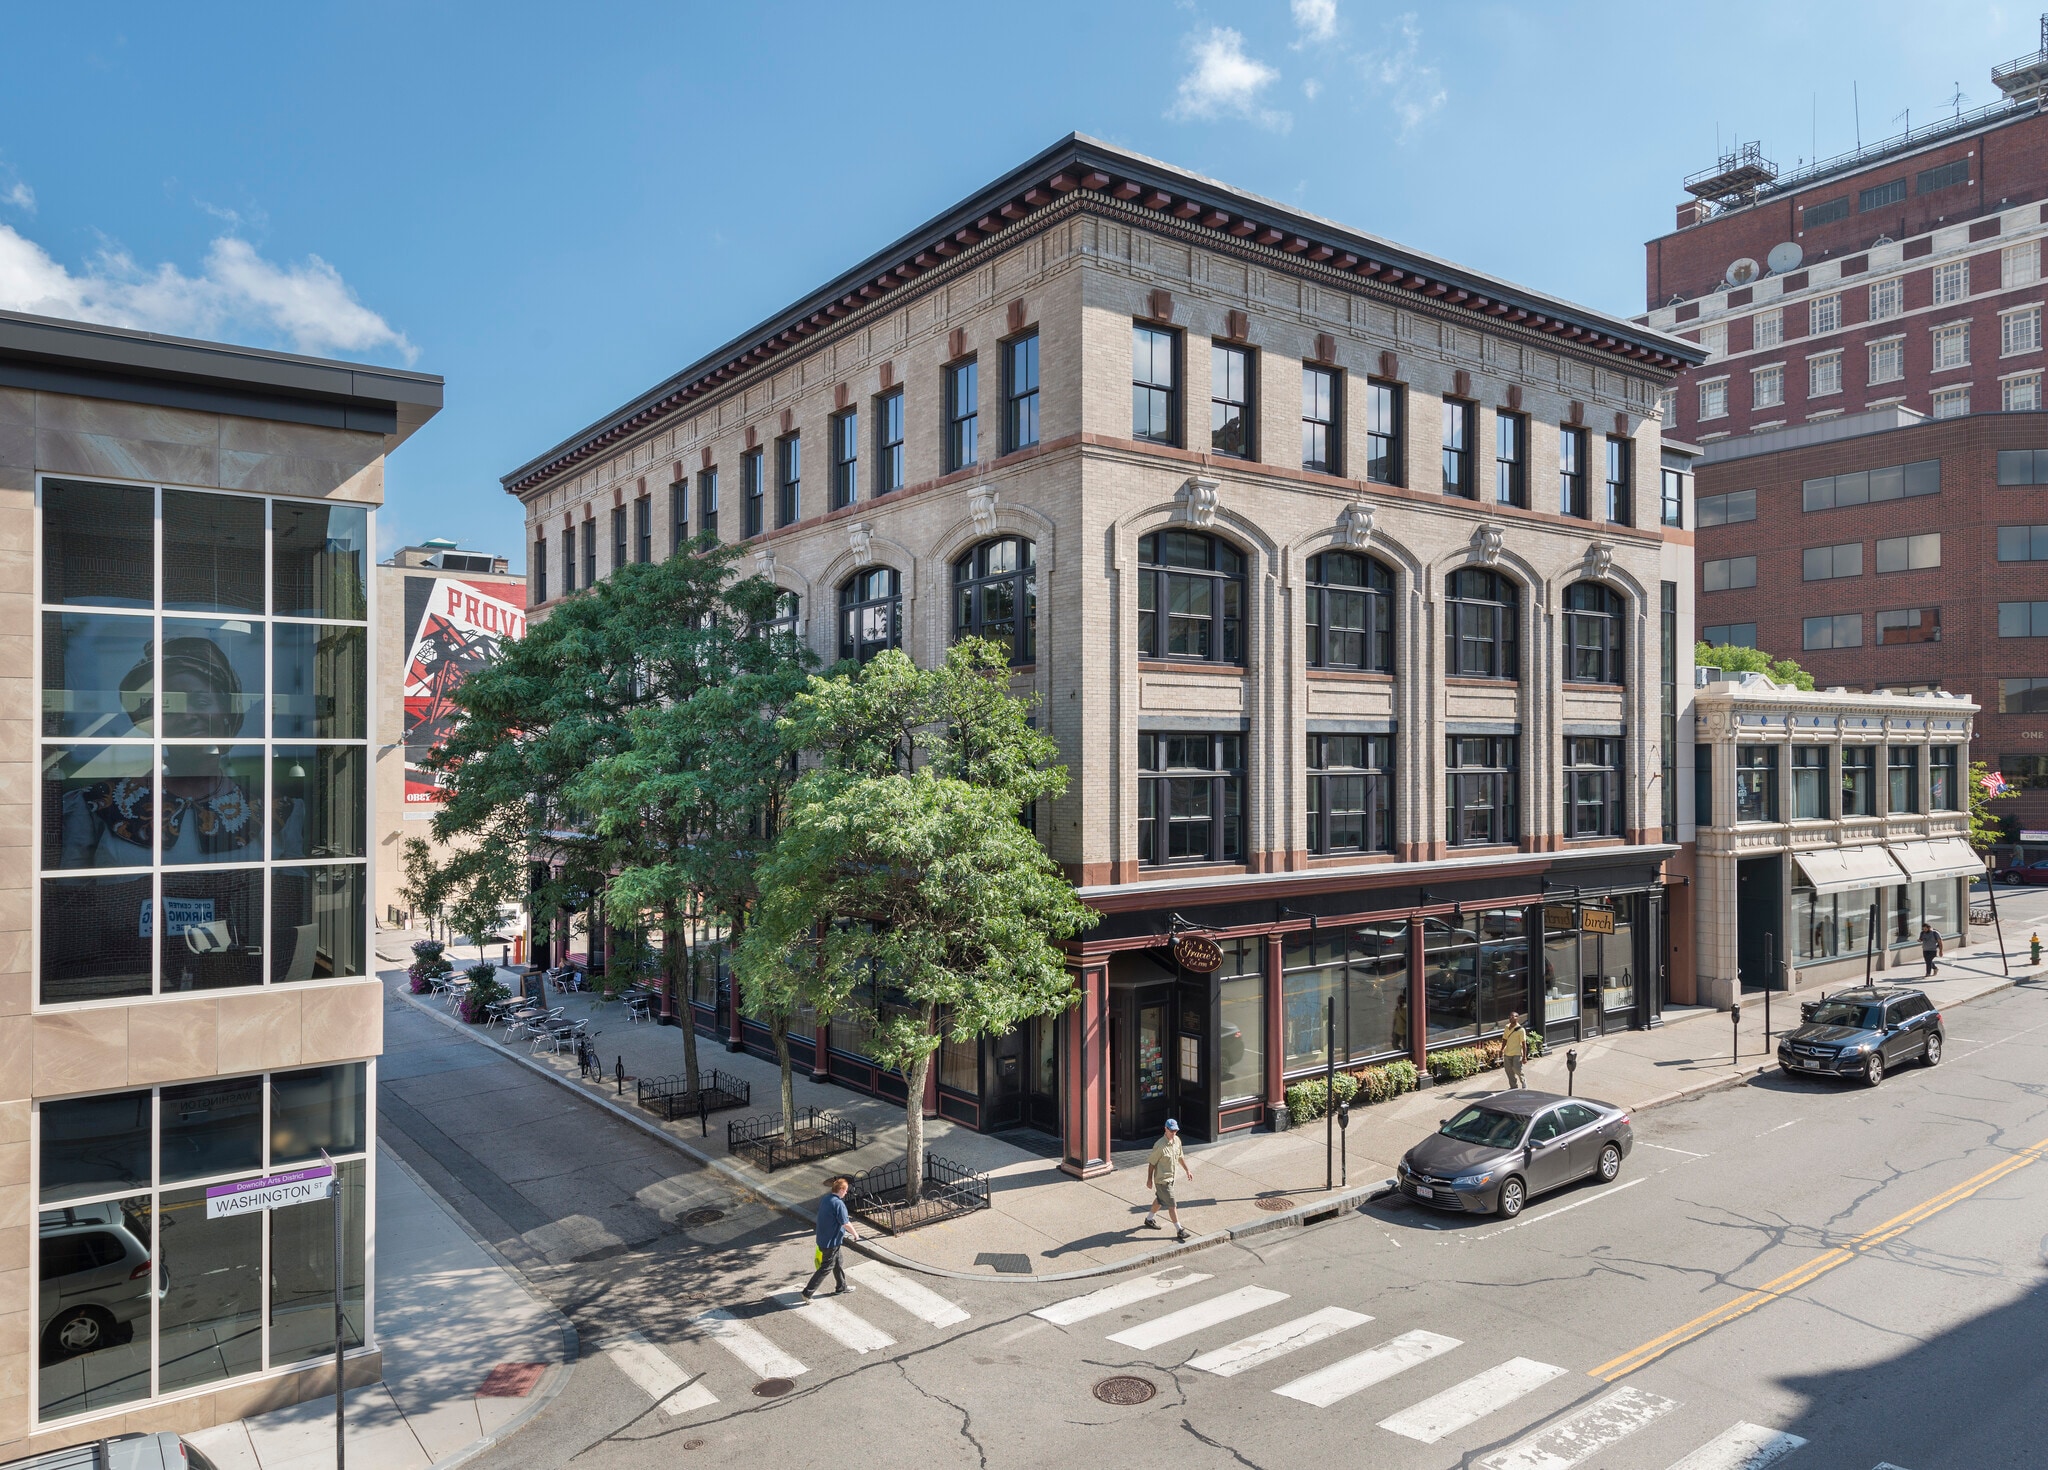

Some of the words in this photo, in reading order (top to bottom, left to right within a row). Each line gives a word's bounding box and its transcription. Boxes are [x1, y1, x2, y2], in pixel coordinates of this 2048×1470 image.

[2021, 731, 2045, 739] ONE
[406, 793, 431, 802] OBEY
[1584, 912, 1611, 930] birch
[1179, 940, 1217, 961] Gracie's
[236, 1180, 267, 1191] Downcity
[267, 1177, 281, 1185] Arts
[282, 1172, 304, 1182] District
[216, 1184, 311, 1213] WASHINGTON
